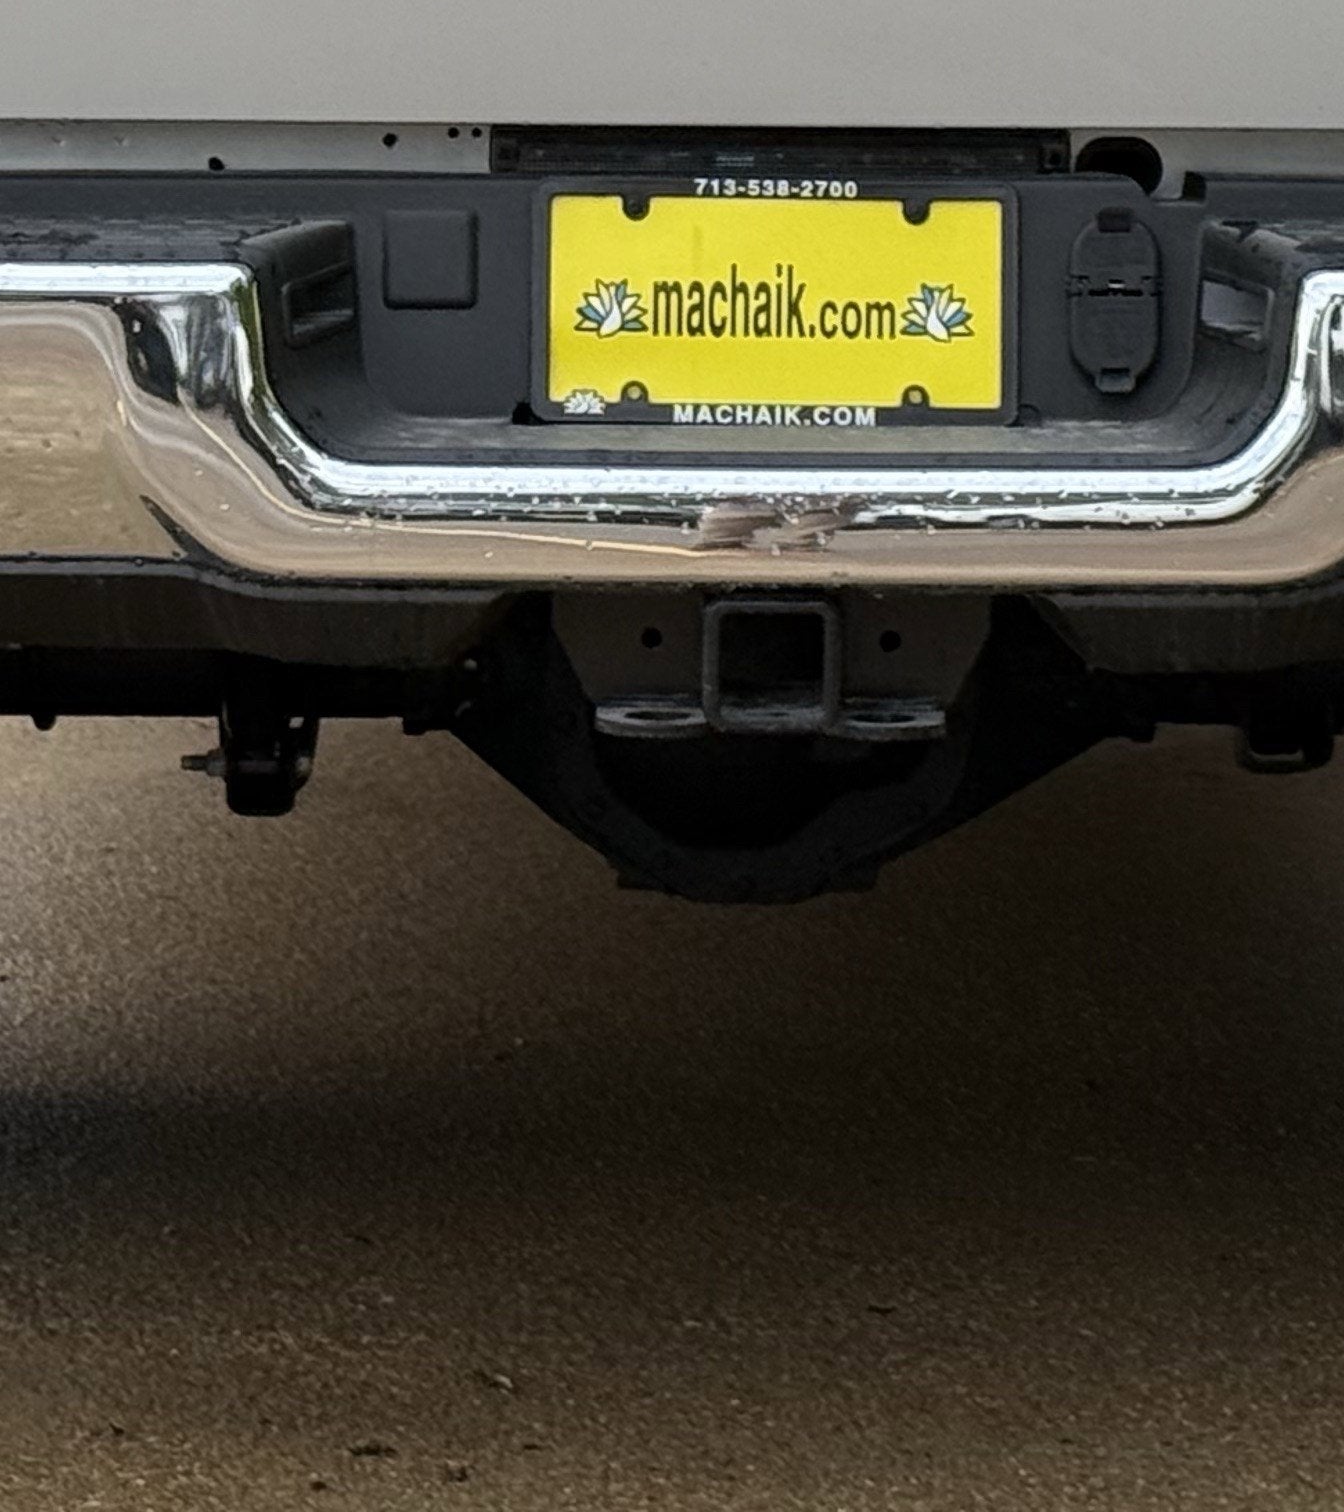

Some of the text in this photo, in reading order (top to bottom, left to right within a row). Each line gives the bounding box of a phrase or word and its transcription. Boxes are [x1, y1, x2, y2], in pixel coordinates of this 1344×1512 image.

[693, 178, 858, 199] 713-538-2700
[652, 263, 897, 340] machaik.com
[672, 404, 877, 427] MACHAIK.COM
